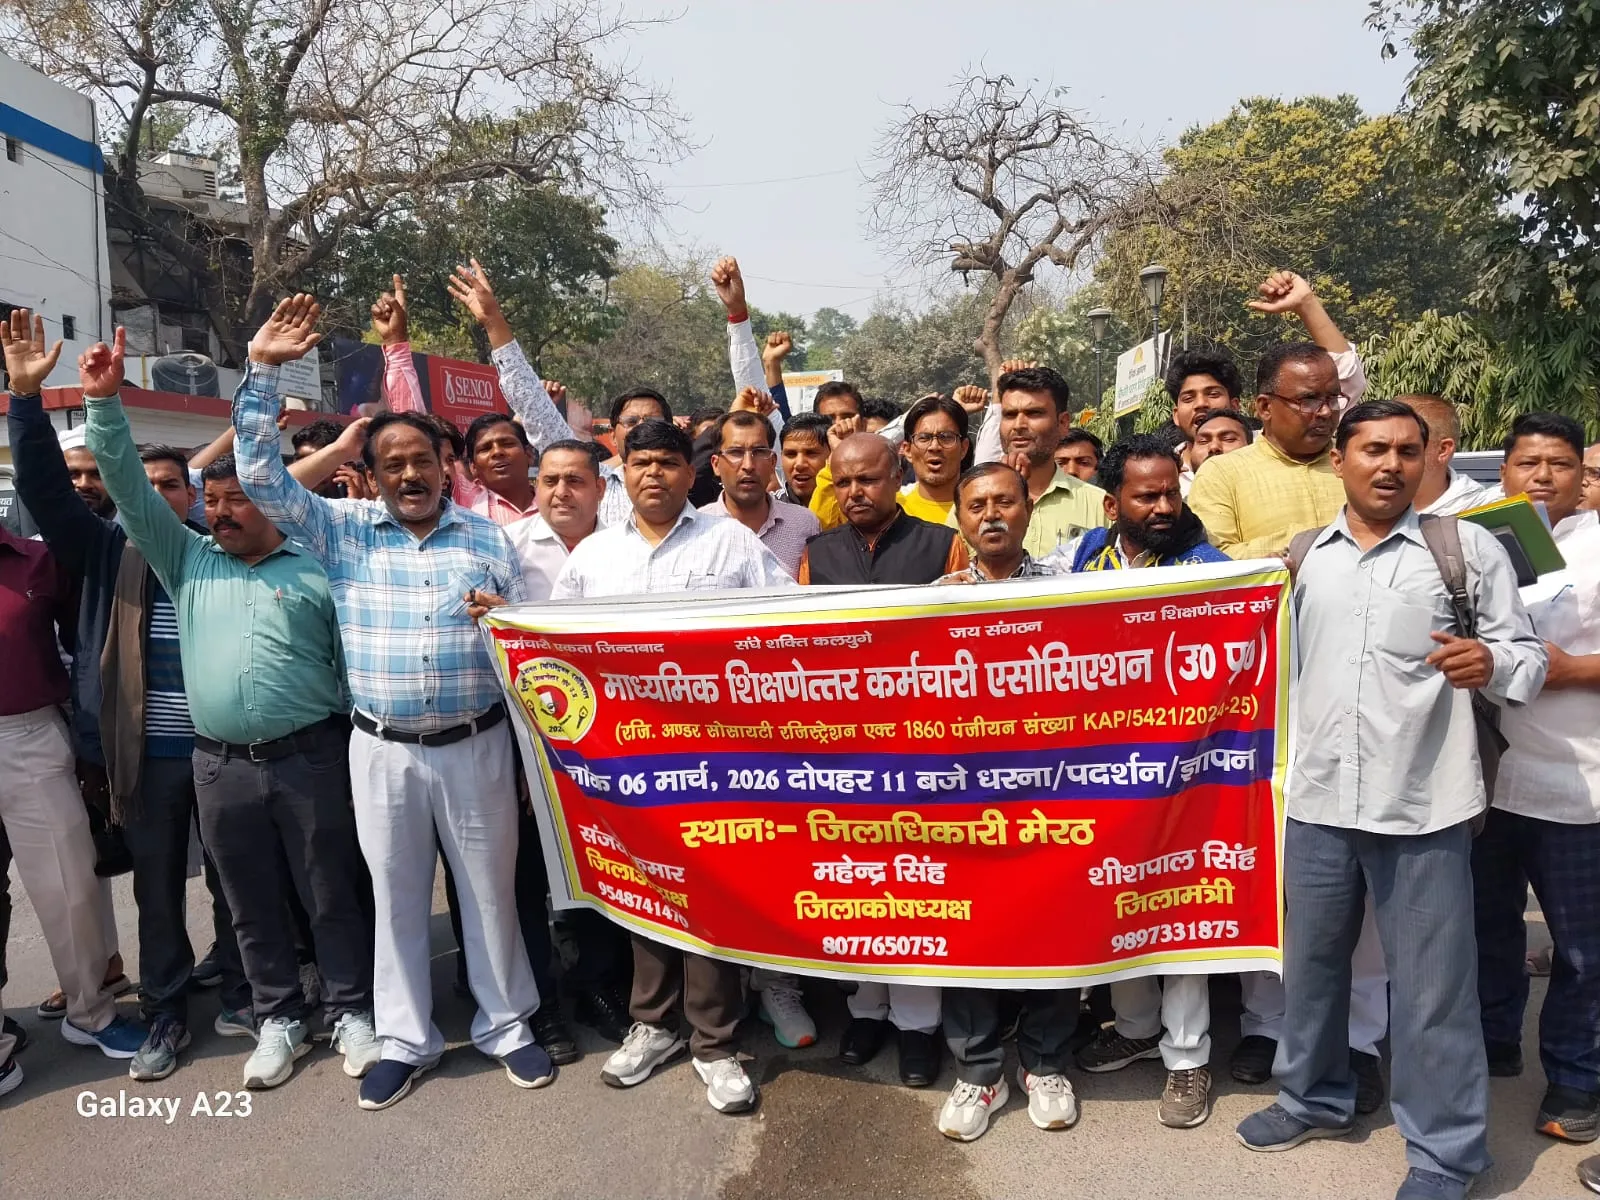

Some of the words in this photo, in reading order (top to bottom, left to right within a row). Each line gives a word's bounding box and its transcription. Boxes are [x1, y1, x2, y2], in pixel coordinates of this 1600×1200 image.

[455, 376, 493, 400] SENCO
[1123, 610, 1157, 624] जय
[1161, 601, 1246, 621] शिक्षणेत्तर
[734, 636, 762, 650] संघे
[766, 634, 809, 650] शक्ति
[813, 630, 873, 649] कलयुगे
[949, 625, 981, 639] जय
[985, 620, 1043, 638] संगठन
[596, 641, 665, 654] जिन्दाबाद
[600, 661, 720, 704] माध्यमिक
[725, 657, 860, 704] शिक्षणेत्तर
[864, 649, 978, 699] कर्मचारी
[984, 641, 1154, 698] एसोसिएशन
[615, 719, 656, 745] (रजि.
[661, 722, 701, 738] अण्डर
[705, 720, 773, 739] सोसायटी
[778, 720, 858, 744] रजिस्ट्रेशन
[862, 723, 896, 739] एक्ट
[903, 720, 946, 738] 1860
[950, 715, 1018, 738] पंजीयन
[1021, 711, 1077, 735] संख्या
[618, 772, 648, 796] 06
[653, 761, 719, 792] मार्च,
[727, 768, 780, 791] 2026
[786, 761, 874, 794] दोपहर
[881, 770, 906, 792] 11
[915, 763, 968, 792] बजे
[805, 808, 1009, 846] जिलाधिकारी
[1016, 808, 1096, 846] मेरठ
[812, 853, 888, 887] महेन्द्र
[893, 853, 948, 885] सिंह
[1088, 857, 1197, 887] शीशपाल
[1201, 840, 1258, 872] सिंह
[793, 890, 973, 921] जिलाकोषध्यक्ष
[1114, 877, 1235, 919] जिलामंत्री
[822, 936, 948, 956] 8077650752
[1111, 920, 1240, 953] 9897331875
